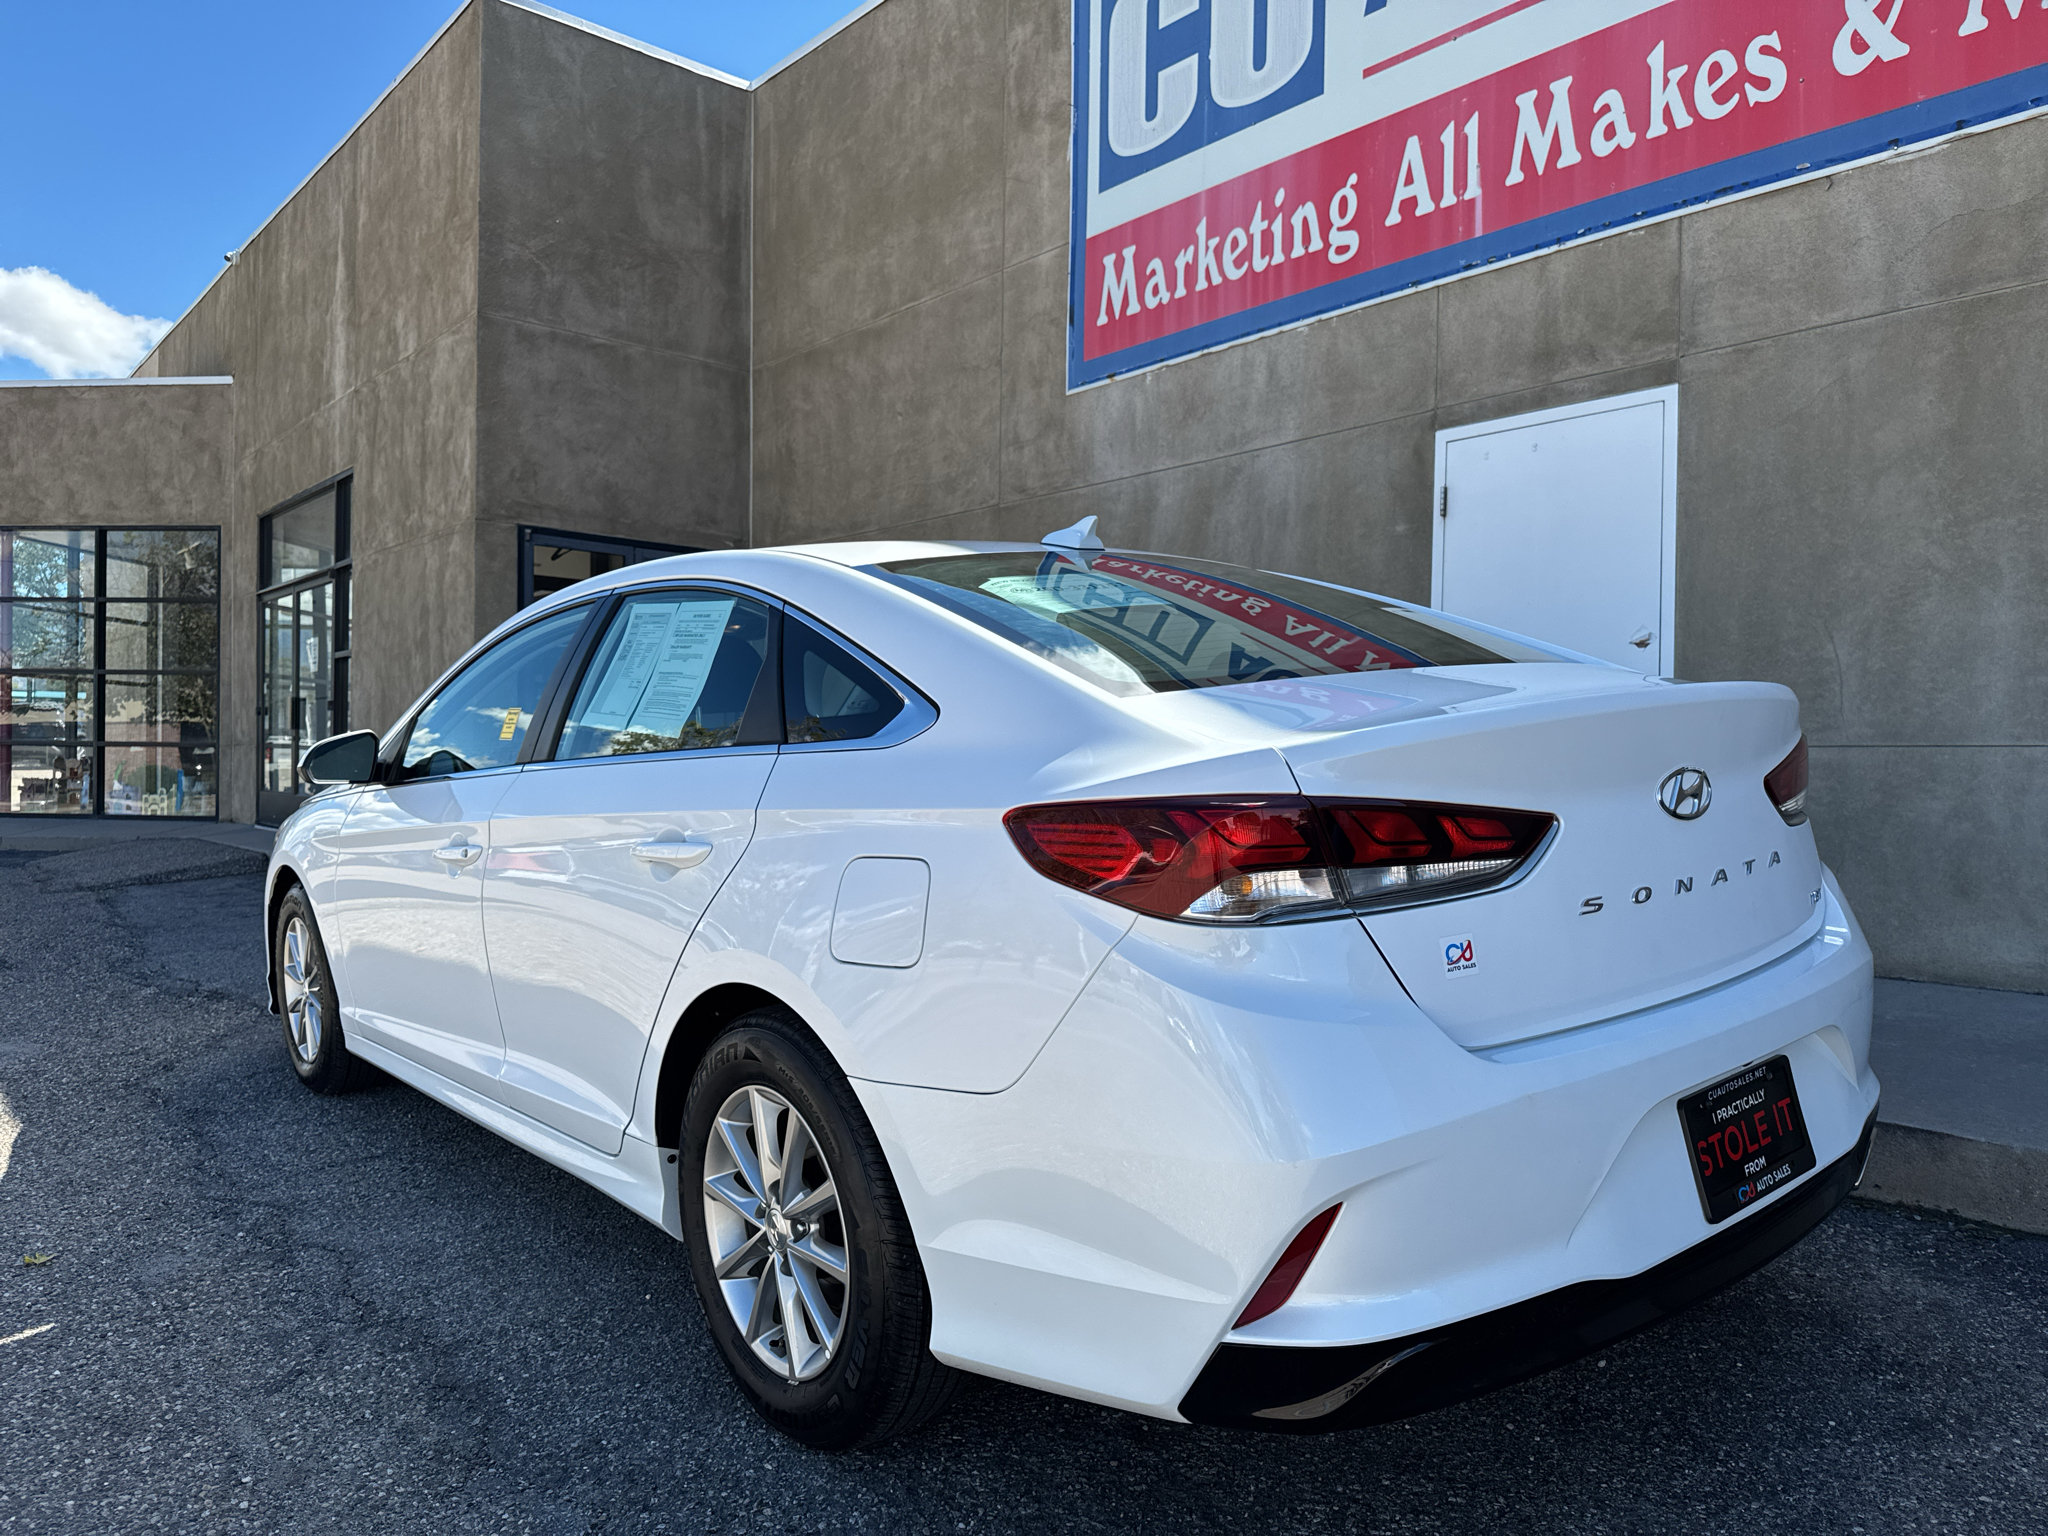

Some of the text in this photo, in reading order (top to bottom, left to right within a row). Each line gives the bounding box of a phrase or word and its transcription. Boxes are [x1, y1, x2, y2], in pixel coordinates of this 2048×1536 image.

[1096, 0, 1911, 327] Marketing All Makes &
[1578, 851, 1772, 916] SONATA
[1462, 962, 1477, 970] SALES
[1707, 1066, 1767, 1101] CUAUTOSALES.NET
[1712, 1088, 1766, 1125] I PRACTICALLY
[1697, 1097, 1793, 1177] STOLE IT
[1744, 1155, 1767, 1177] FROM
[1756, 1174, 1774, 1193] AUTO
[1773, 1163, 1791, 1183] SALES
